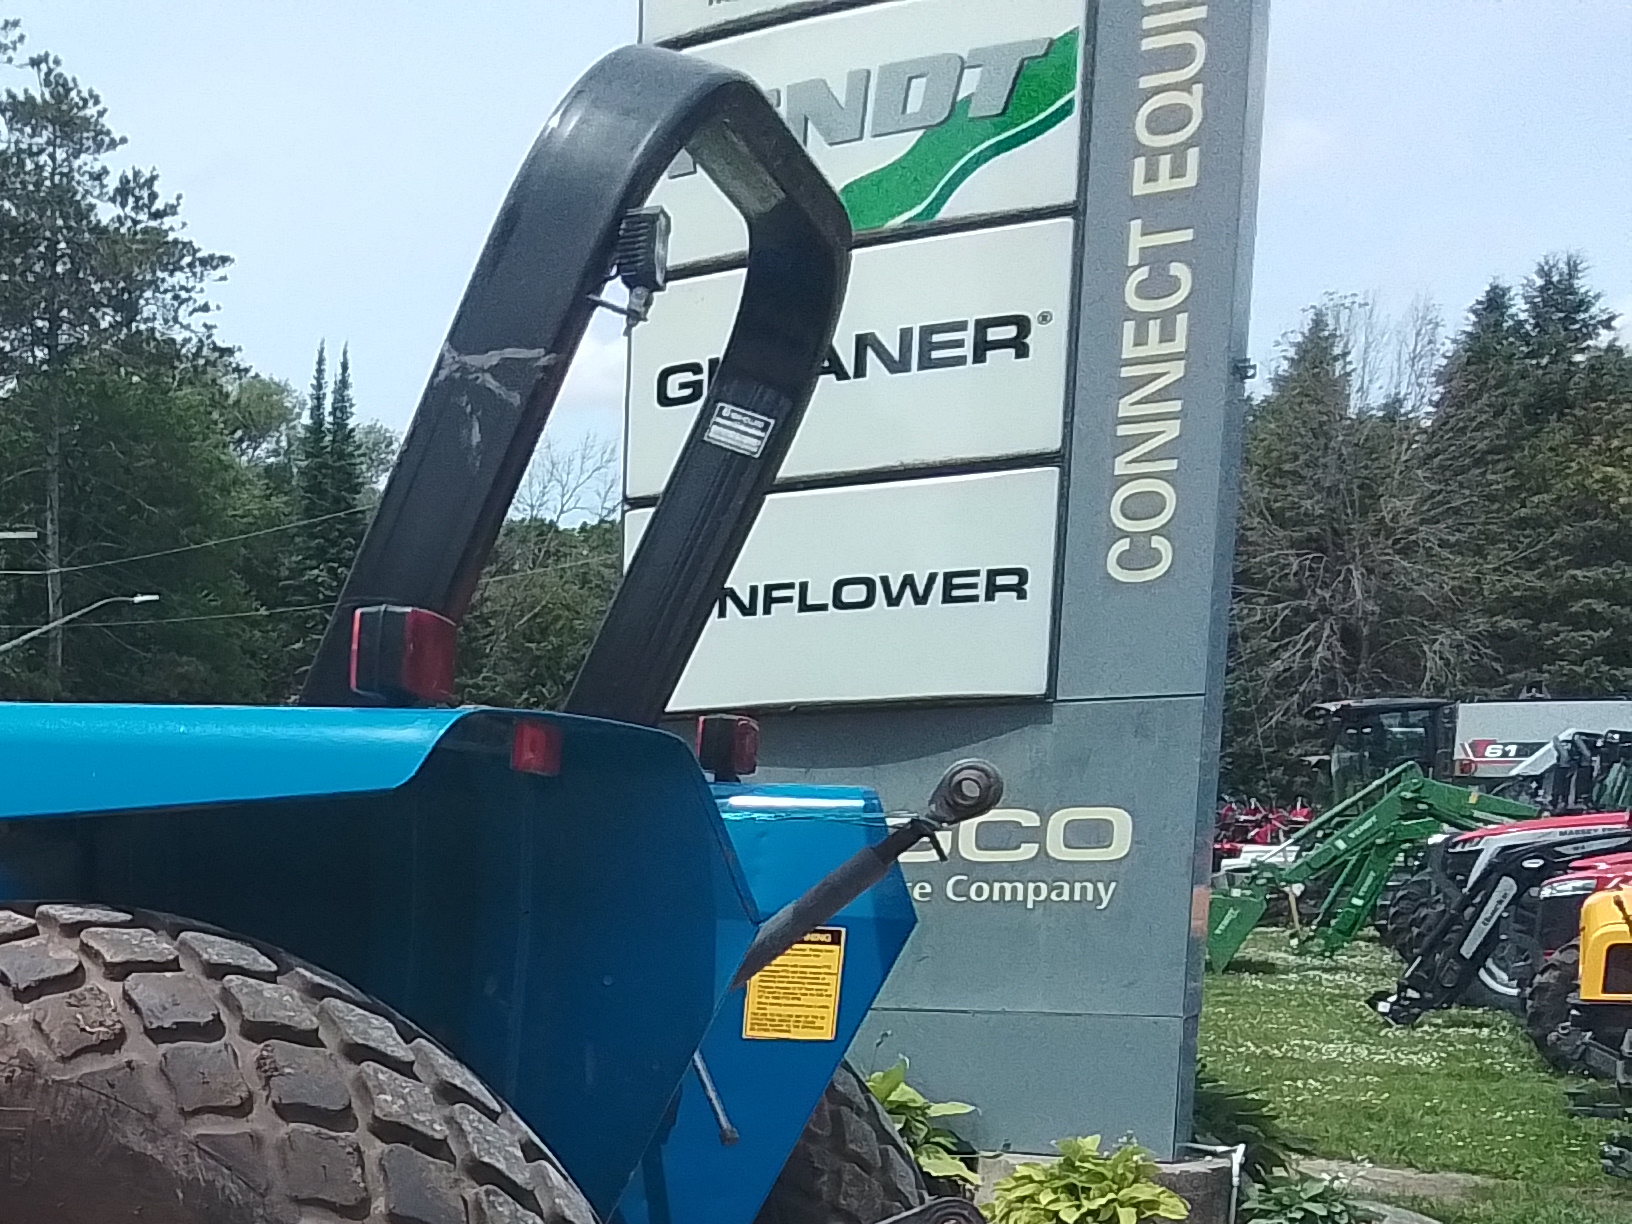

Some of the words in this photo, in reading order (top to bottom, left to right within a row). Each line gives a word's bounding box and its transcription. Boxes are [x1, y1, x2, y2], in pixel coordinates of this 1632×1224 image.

[1131, 0, 1208, 196] EQUI
[656, 314, 1032, 407] GANER
[1106, 218, 1194, 583] CONNECT
[717, 566, 1029, 619] NFLOWER
[945, 875, 1117, 910] Company
